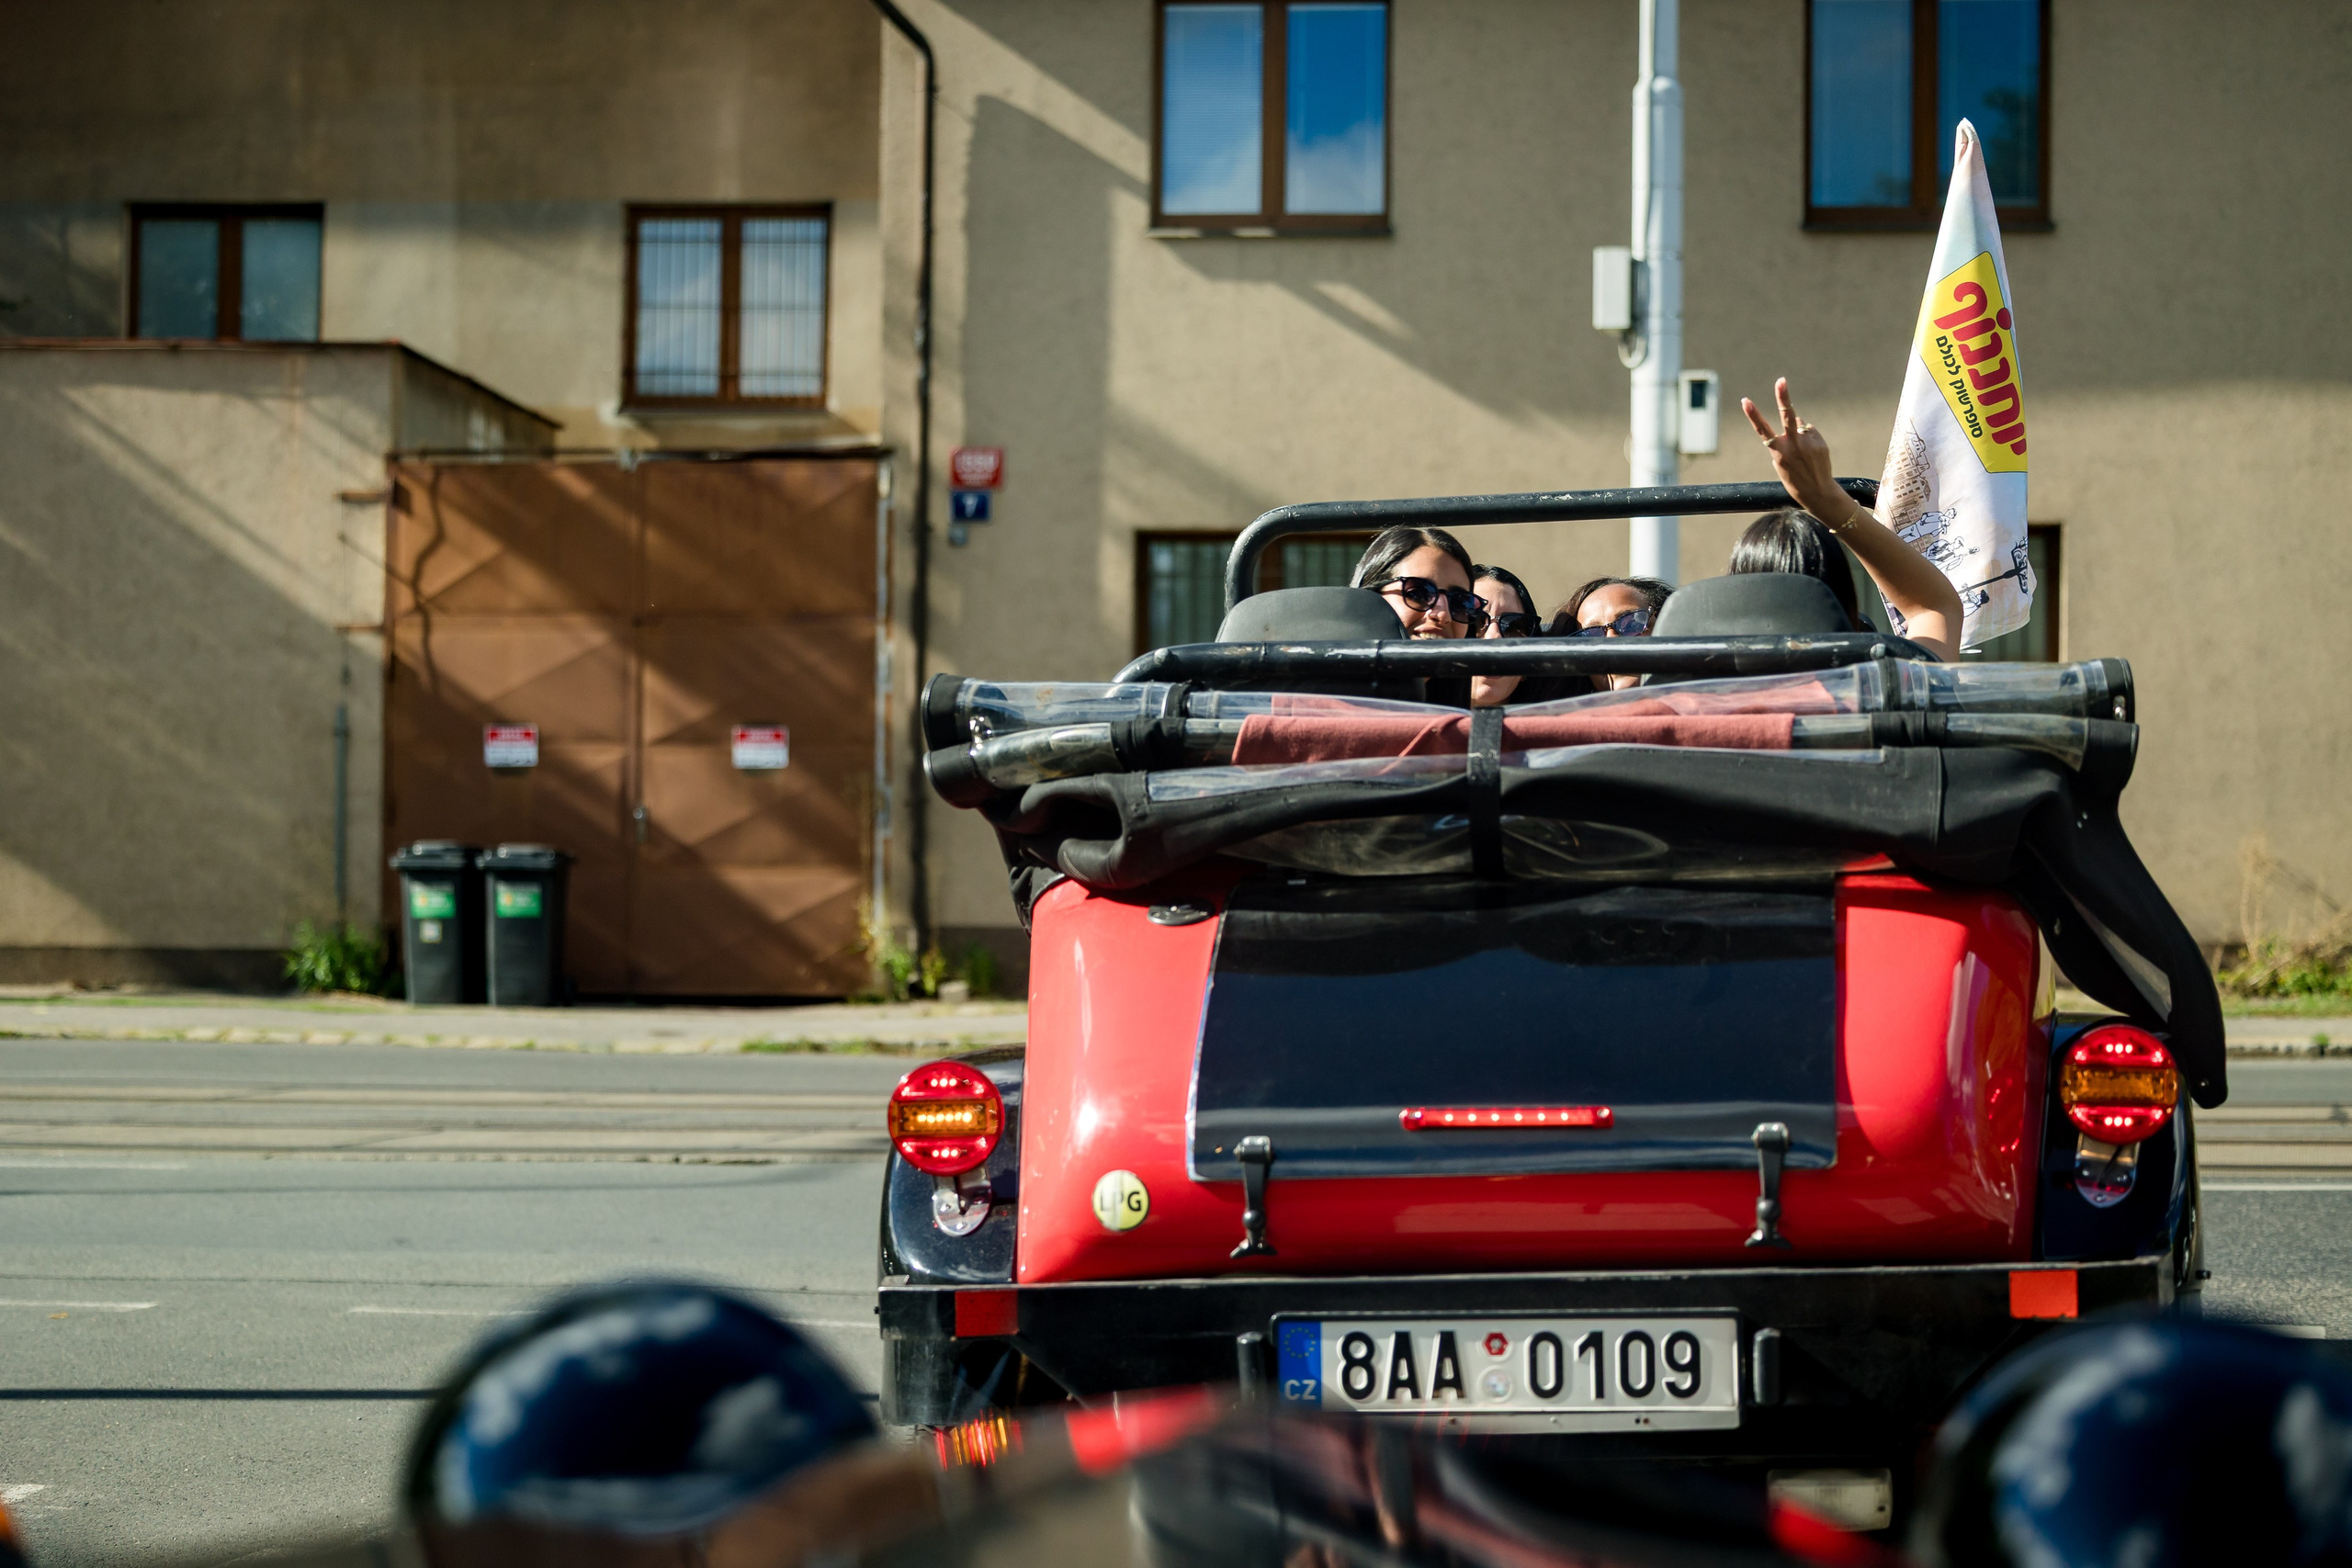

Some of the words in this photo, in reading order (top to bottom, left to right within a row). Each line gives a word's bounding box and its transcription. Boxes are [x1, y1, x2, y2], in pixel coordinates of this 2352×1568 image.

[1934, 281, 2027, 456] יוחננוף
[1936, 335, 1962, 376] לכולם
[1949, 378, 1983, 438] סופרשוק
[1100, 1190, 1141, 1212] LPG
[1284, 1379, 1317, 1401] CZ
[1340, 1331, 1466, 1400] 8AA
[1529, 1331, 1702, 1399] 0109
